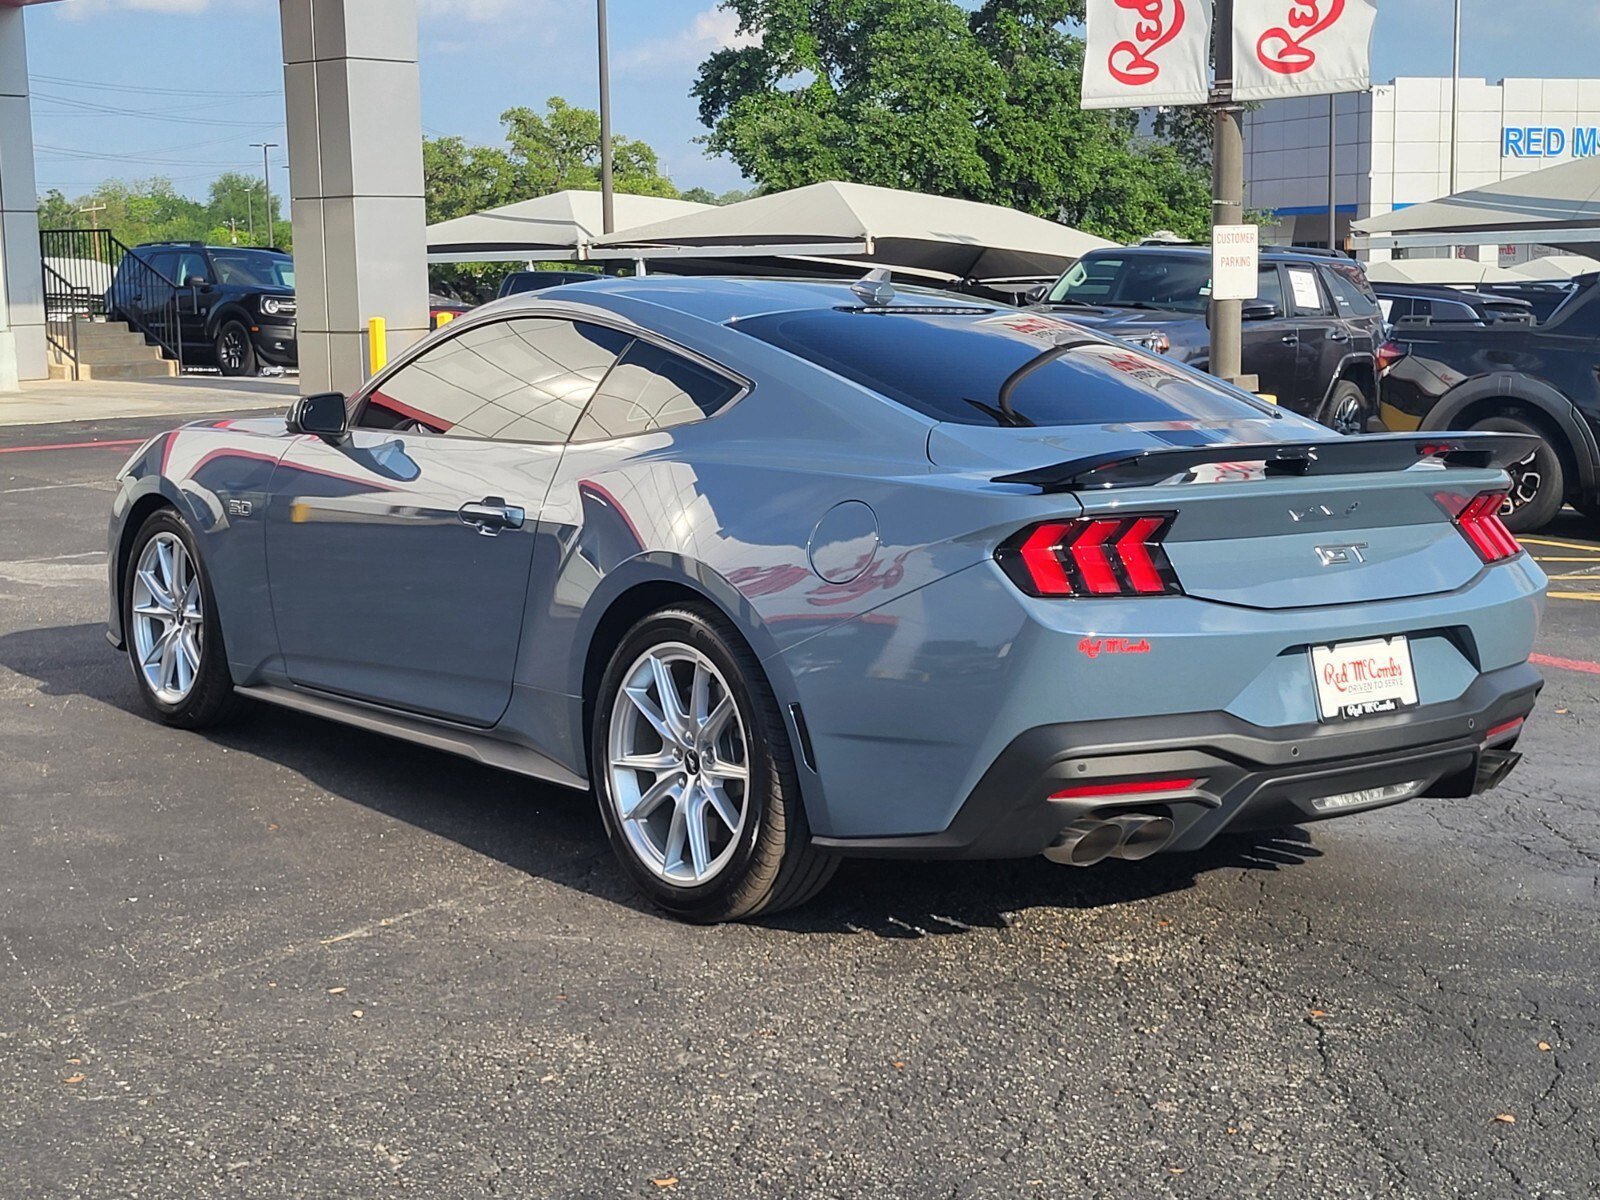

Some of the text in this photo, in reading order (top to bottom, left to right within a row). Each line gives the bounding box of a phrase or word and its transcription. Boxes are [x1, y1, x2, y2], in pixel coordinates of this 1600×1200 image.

[1503, 126, 1565, 156] RED
[1216, 232, 1255, 244] CUSTOMER
[1220, 255, 1251, 268] PARKING
[1313, 541, 1369, 566] GT
[1079, 637, 1101, 659] Red
[1324, 657, 1402, 692] Red McCombs
[1348, 678, 1404, 693] DRIVEN TO SERVE
[1347, 704, 1362, 717] Red
